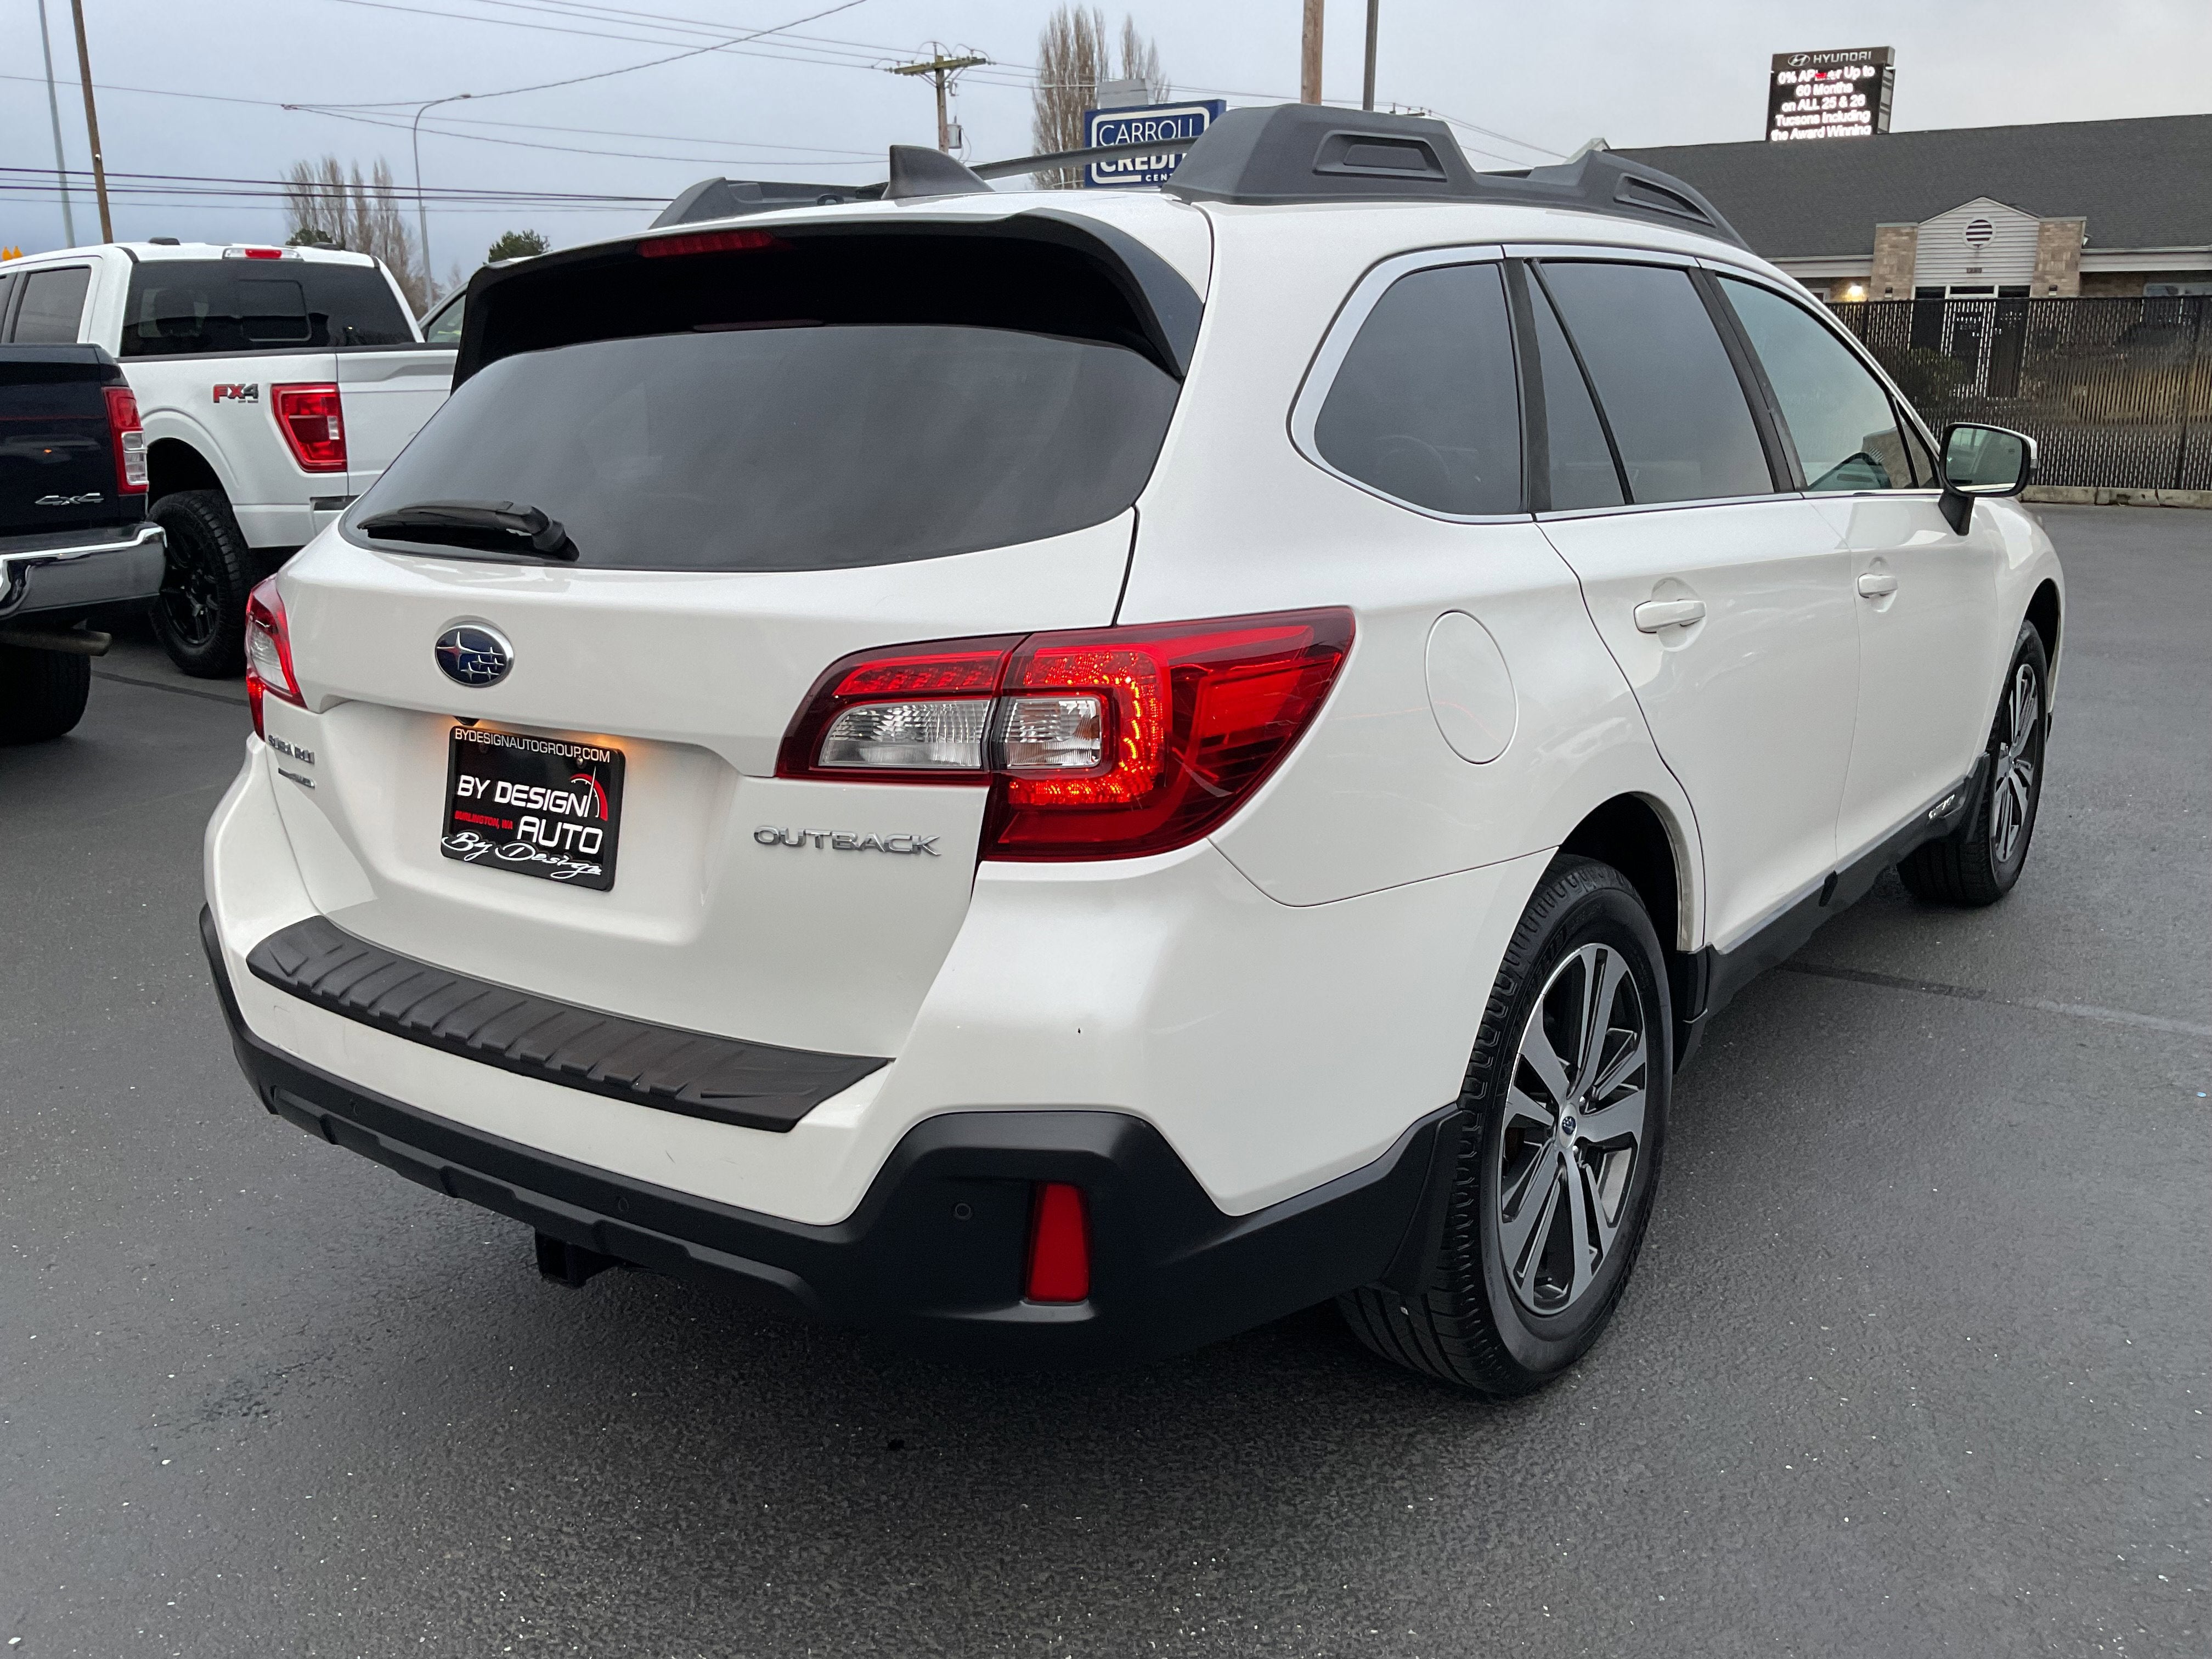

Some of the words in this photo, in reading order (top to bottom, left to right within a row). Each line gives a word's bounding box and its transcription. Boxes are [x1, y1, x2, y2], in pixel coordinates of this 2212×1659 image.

[1813, 51, 1871, 64] HYUNDAI
[1778, 71, 1797, 84] 0%
[1844, 66, 1860, 80] Up
[1863, 65, 1875, 77] to
[1796, 84, 1811, 97] 60
[1813, 82, 1853, 95] Months
[1781, 101, 1796, 112] on
[1797, 98, 1820, 111] ALL
[1821, 96, 1837, 109] 25
[1838, 96, 1848, 108] &
[1775, 114, 1820, 127] Tucsons
[1822, 110, 1871, 123] Including
[1770, 129, 1788, 141] the
[1790, 126, 1826, 140] Award
[1100, 152, 1187, 173] CREDI
[1145, 173, 1173, 182] CEN
[213, 383, 258, 403] FX4
[454, 727, 610, 764] BYDESIGNAUTOGROUP.COM
[457, 775, 491, 799] BY
[494, 781, 589, 817] DESIGN
[501, 819, 513, 830] WA
[517, 815, 603, 854] AUTO
[753, 825, 942, 857] OUTBACK
[441, 832, 493, 862] By
[495, 843, 602, 879] Design
